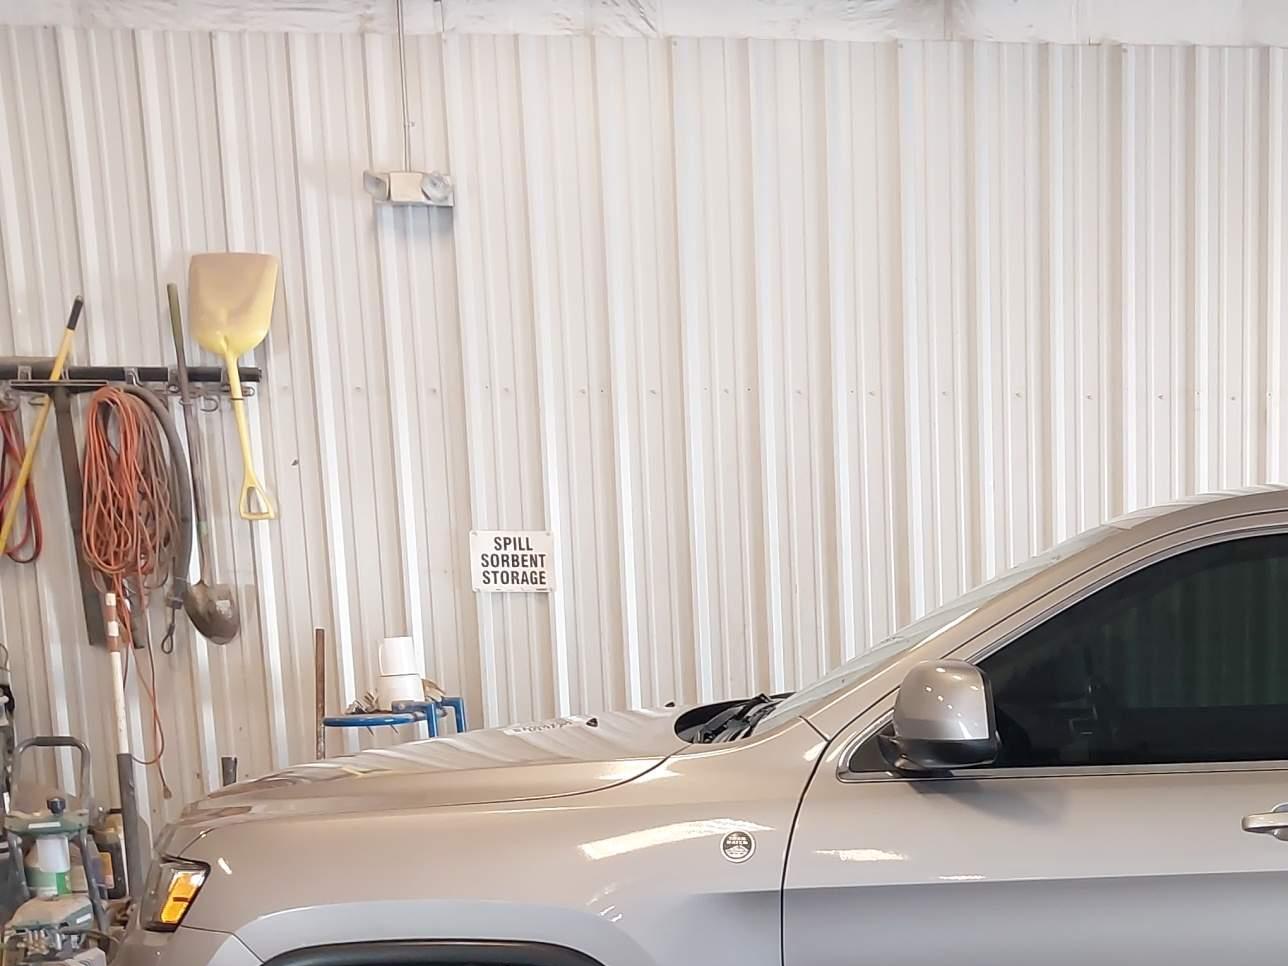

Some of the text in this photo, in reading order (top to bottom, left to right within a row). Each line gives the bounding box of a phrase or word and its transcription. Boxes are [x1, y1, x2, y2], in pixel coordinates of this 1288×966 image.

[493, 536, 534, 551] SPILL
[481, 553, 547, 568] SORBENT
[482, 570, 547, 585] STORAGE
